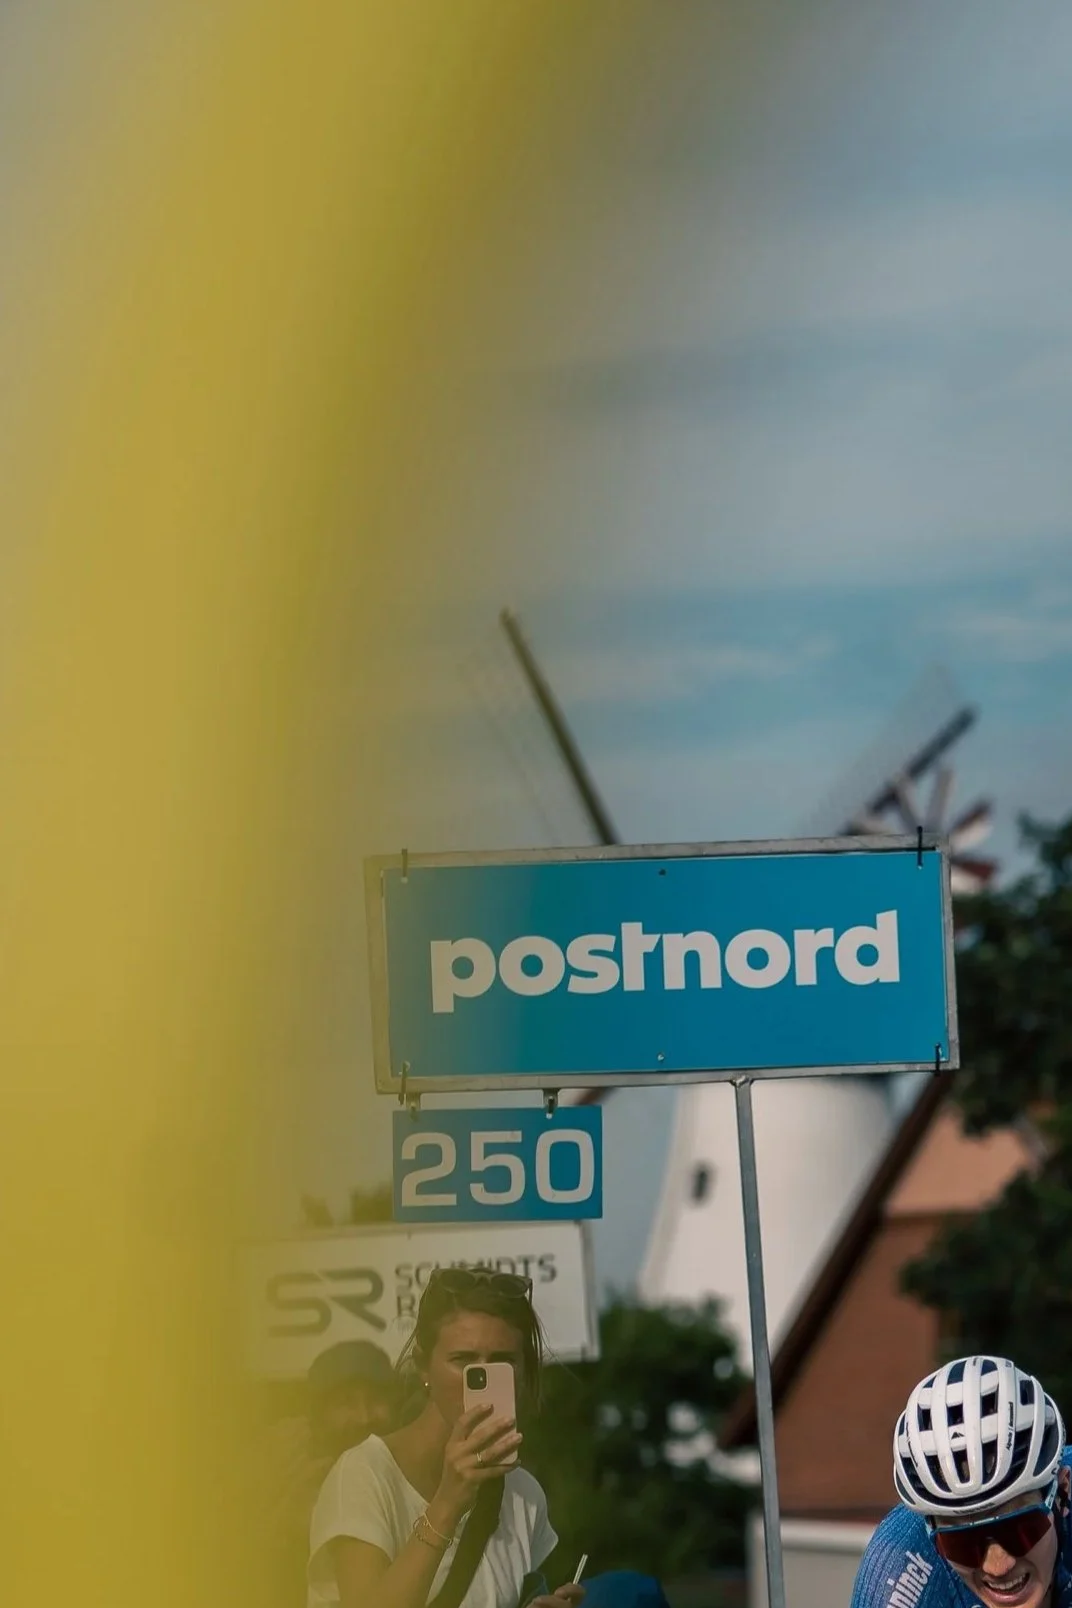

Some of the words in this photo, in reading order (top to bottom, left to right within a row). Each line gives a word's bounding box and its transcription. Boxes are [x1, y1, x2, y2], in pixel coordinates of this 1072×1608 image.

[430, 910, 900, 1014] postnord
[401, 1128, 596, 1207] 250
[266, 1268, 387, 1337] SR
[395, 1254, 557, 1289] SCDTS
